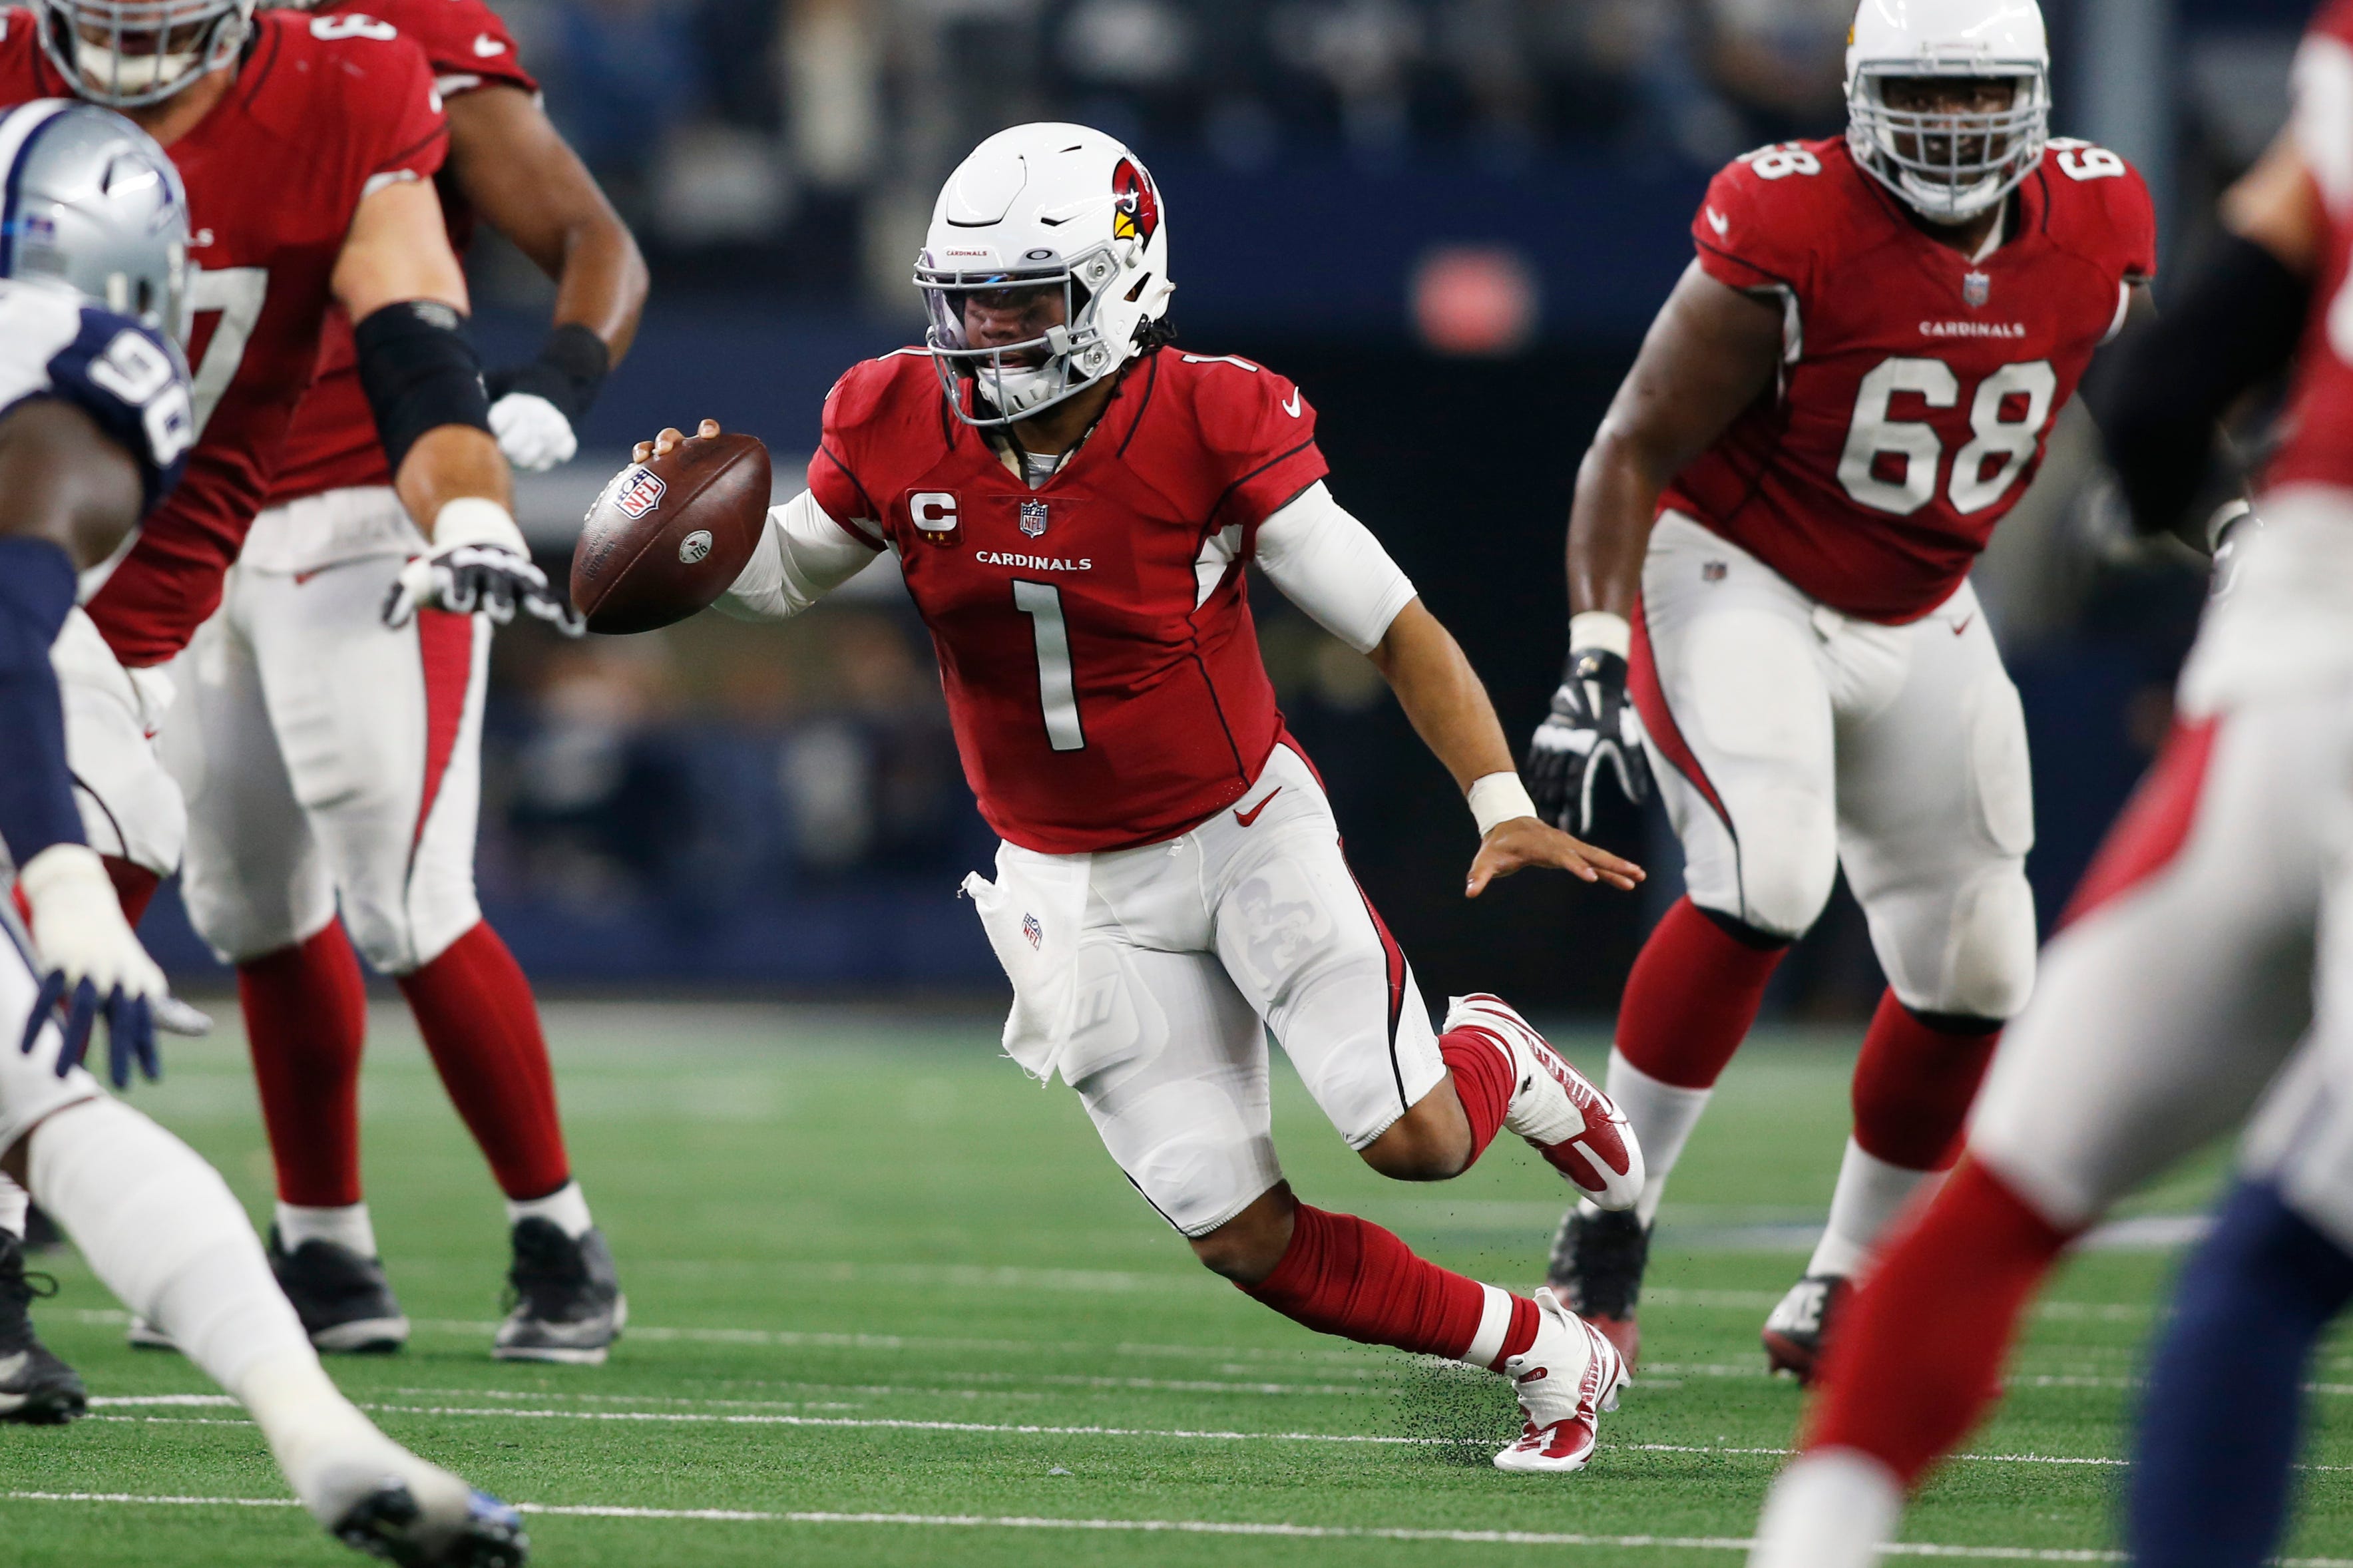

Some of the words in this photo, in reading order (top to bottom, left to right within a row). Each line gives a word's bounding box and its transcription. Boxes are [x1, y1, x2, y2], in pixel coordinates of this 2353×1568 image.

[1918, 321, 2027, 338] CARDINALS
[85, 328, 194, 469] 90
[1836, 357, 2057, 516] 68
[622, 481, 661, 514] NFL
[909, 492, 957, 531] C
[1024, 516, 1043, 530] NFL
[690, 543, 708, 560] 176
[975, 550, 1092, 570] CARDINALS
[1011, 578, 1086, 752] 1
[1023, 922, 1038, 948] NFL
